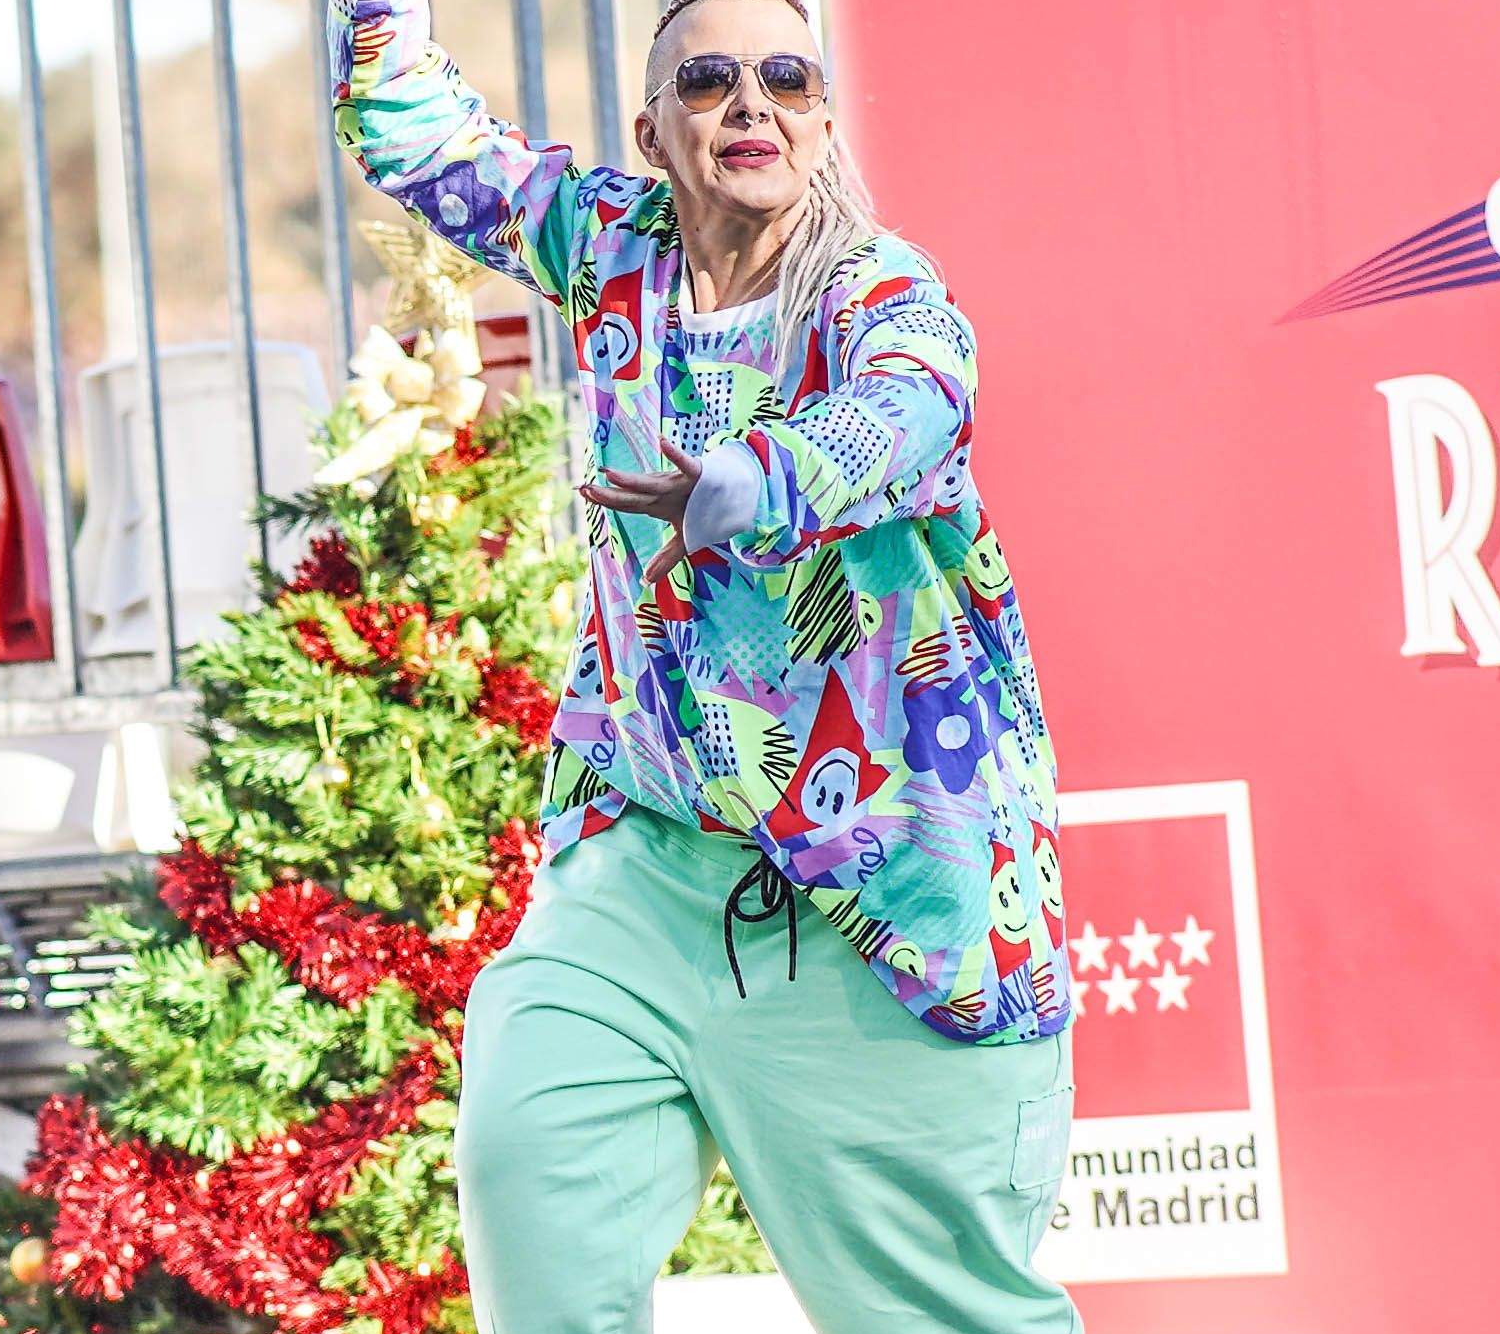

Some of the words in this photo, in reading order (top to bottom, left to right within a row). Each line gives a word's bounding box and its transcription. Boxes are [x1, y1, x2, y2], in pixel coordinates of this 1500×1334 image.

[1071, 1133, 1257, 1177] munidad
[1050, 1202, 1071, 1231] e
[1093, 1182, 1259, 1229] Madrid
